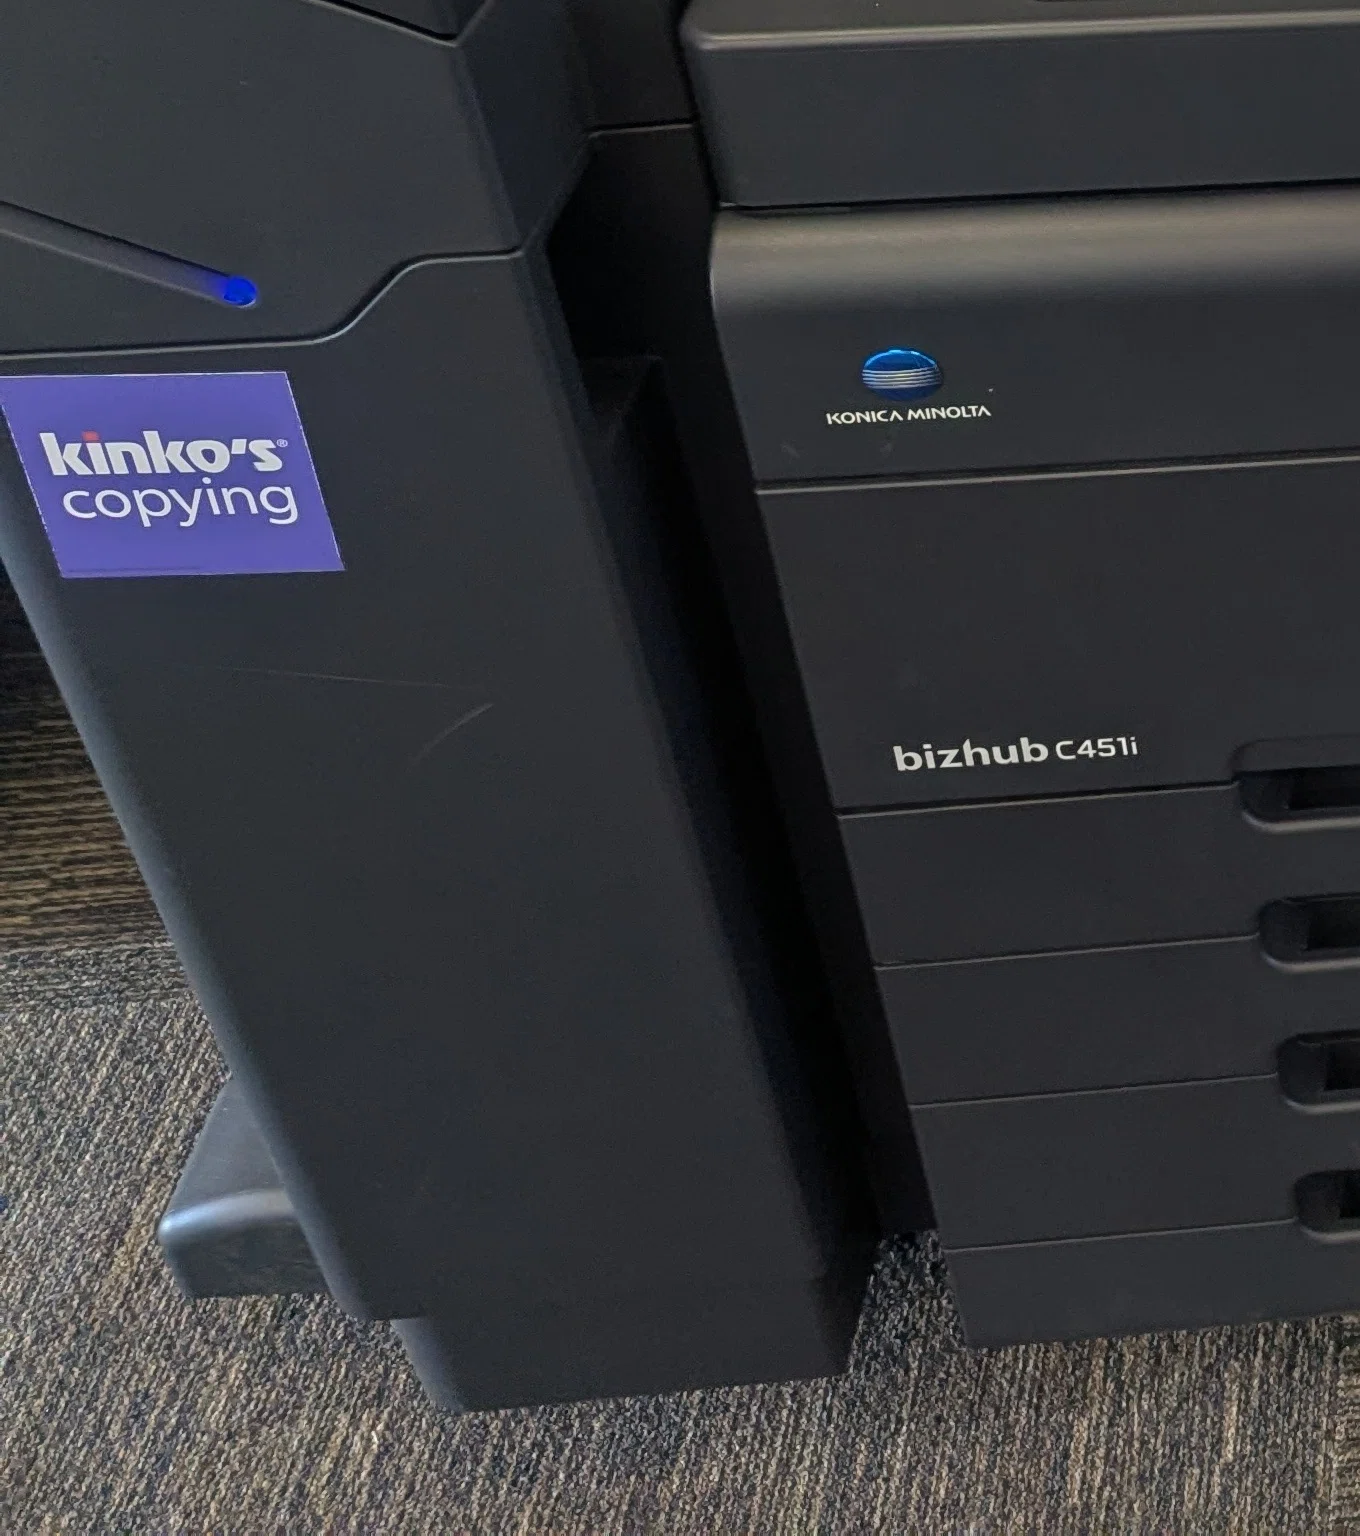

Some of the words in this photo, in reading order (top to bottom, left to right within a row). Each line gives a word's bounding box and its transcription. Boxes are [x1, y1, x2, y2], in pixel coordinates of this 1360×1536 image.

[825, 410, 903, 425] KONICA
[907, 405, 991, 421] MINOLTA
[62, 476, 298, 527] copying
[892, 736, 1049, 771] bizhub
[1055, 736, 1138, 760] C451i
